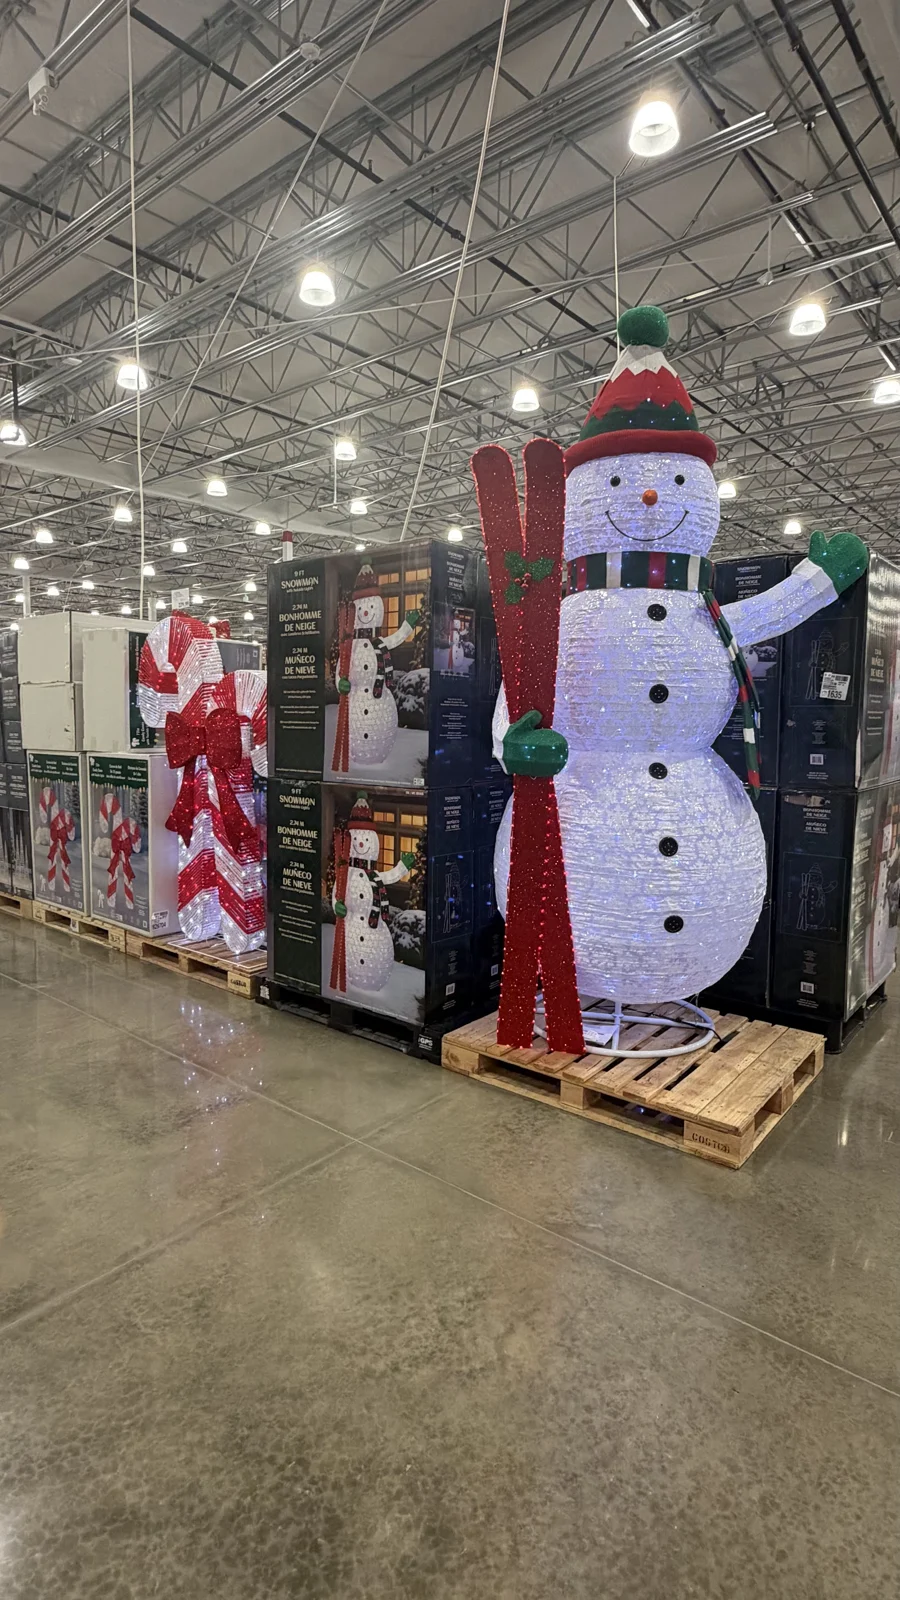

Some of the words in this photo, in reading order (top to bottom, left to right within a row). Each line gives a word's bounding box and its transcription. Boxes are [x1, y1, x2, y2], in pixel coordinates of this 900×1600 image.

[281, 576, 319, 589] SNOWMAN
[279, 610, 322, 622] BONHOMME
[284, 623, 294, 632] DE
[295, 622, 316, 631] NEIGE
[284, 654, 316, 664] MUÑECO
[284, 666, 294, 675] DE
[295, 666, 316, 674] NIEVE
[279, 795, 316, 806] SNOWMAN
[277, 826, 318, 839] BONHOMME
[282, 837, 291, 845] DE
[292, 838, 313, 849] NEIGE
[282, 868, 312, 880] MUÑECO
[282, 878, 291, 886] DE
[292, 879, 312, 891] NIEVE
[692, 1132, 731, 1154] COSTCO
